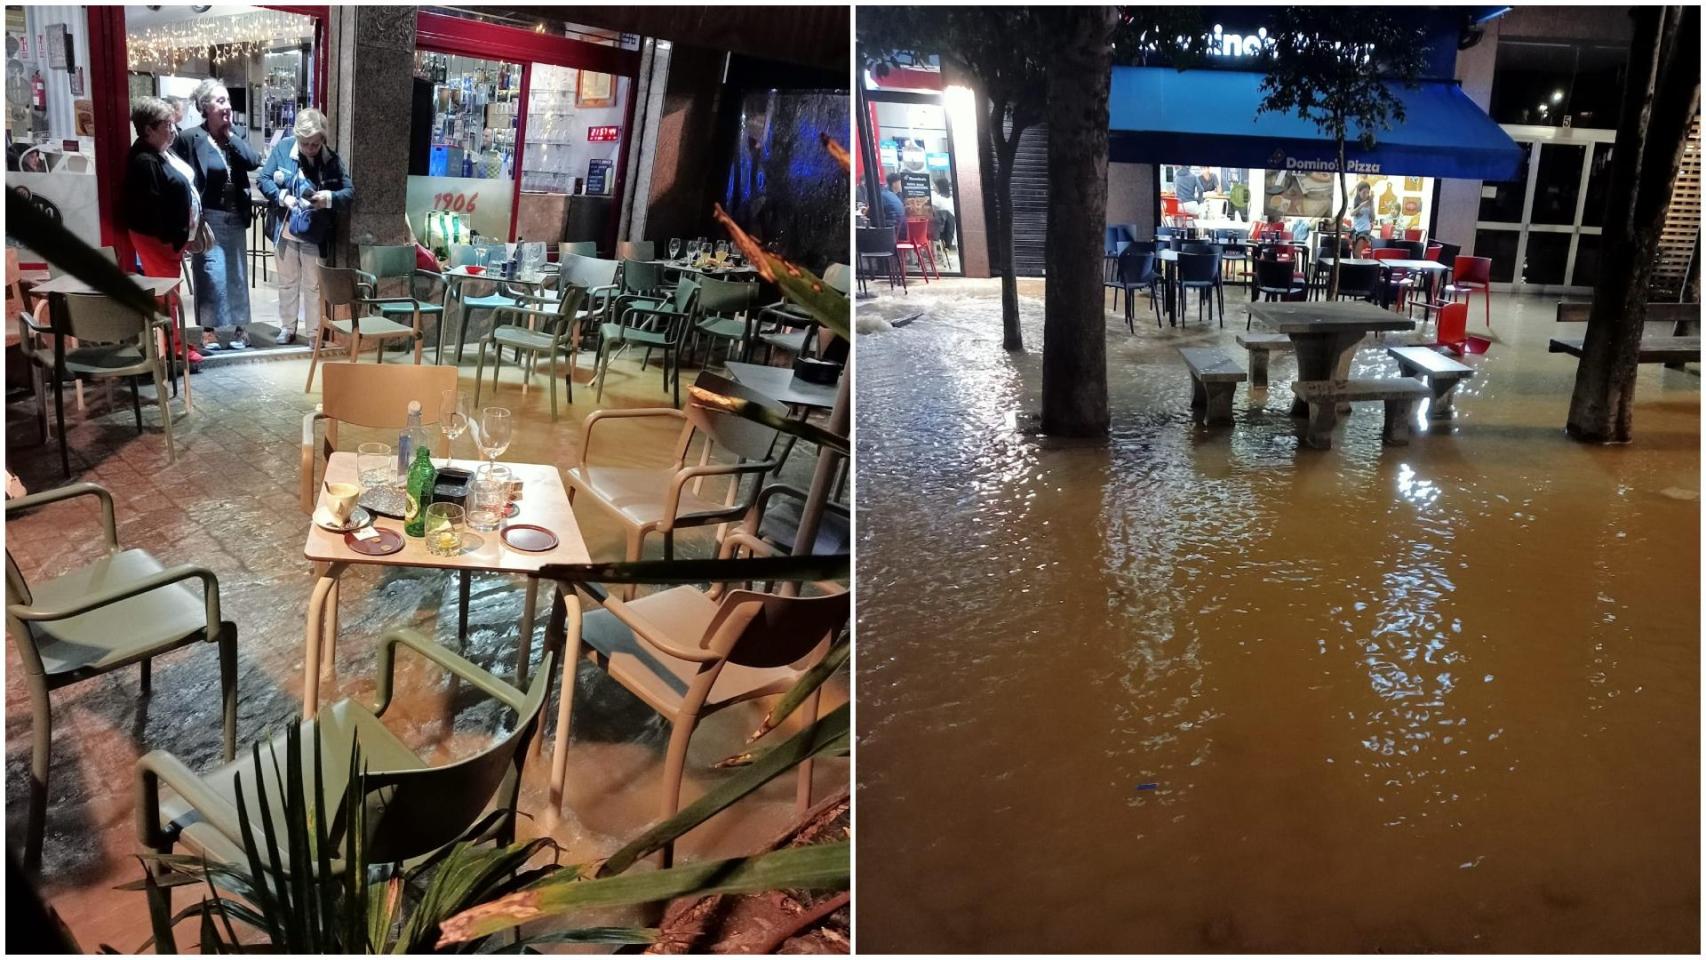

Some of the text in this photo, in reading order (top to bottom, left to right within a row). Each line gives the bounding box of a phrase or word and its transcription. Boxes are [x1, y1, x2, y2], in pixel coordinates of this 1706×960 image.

[1563, 116, 1570, 126] 5
[1347, 160, 1380, 173] Pizza
[434, 191, 479, 213] 1906
